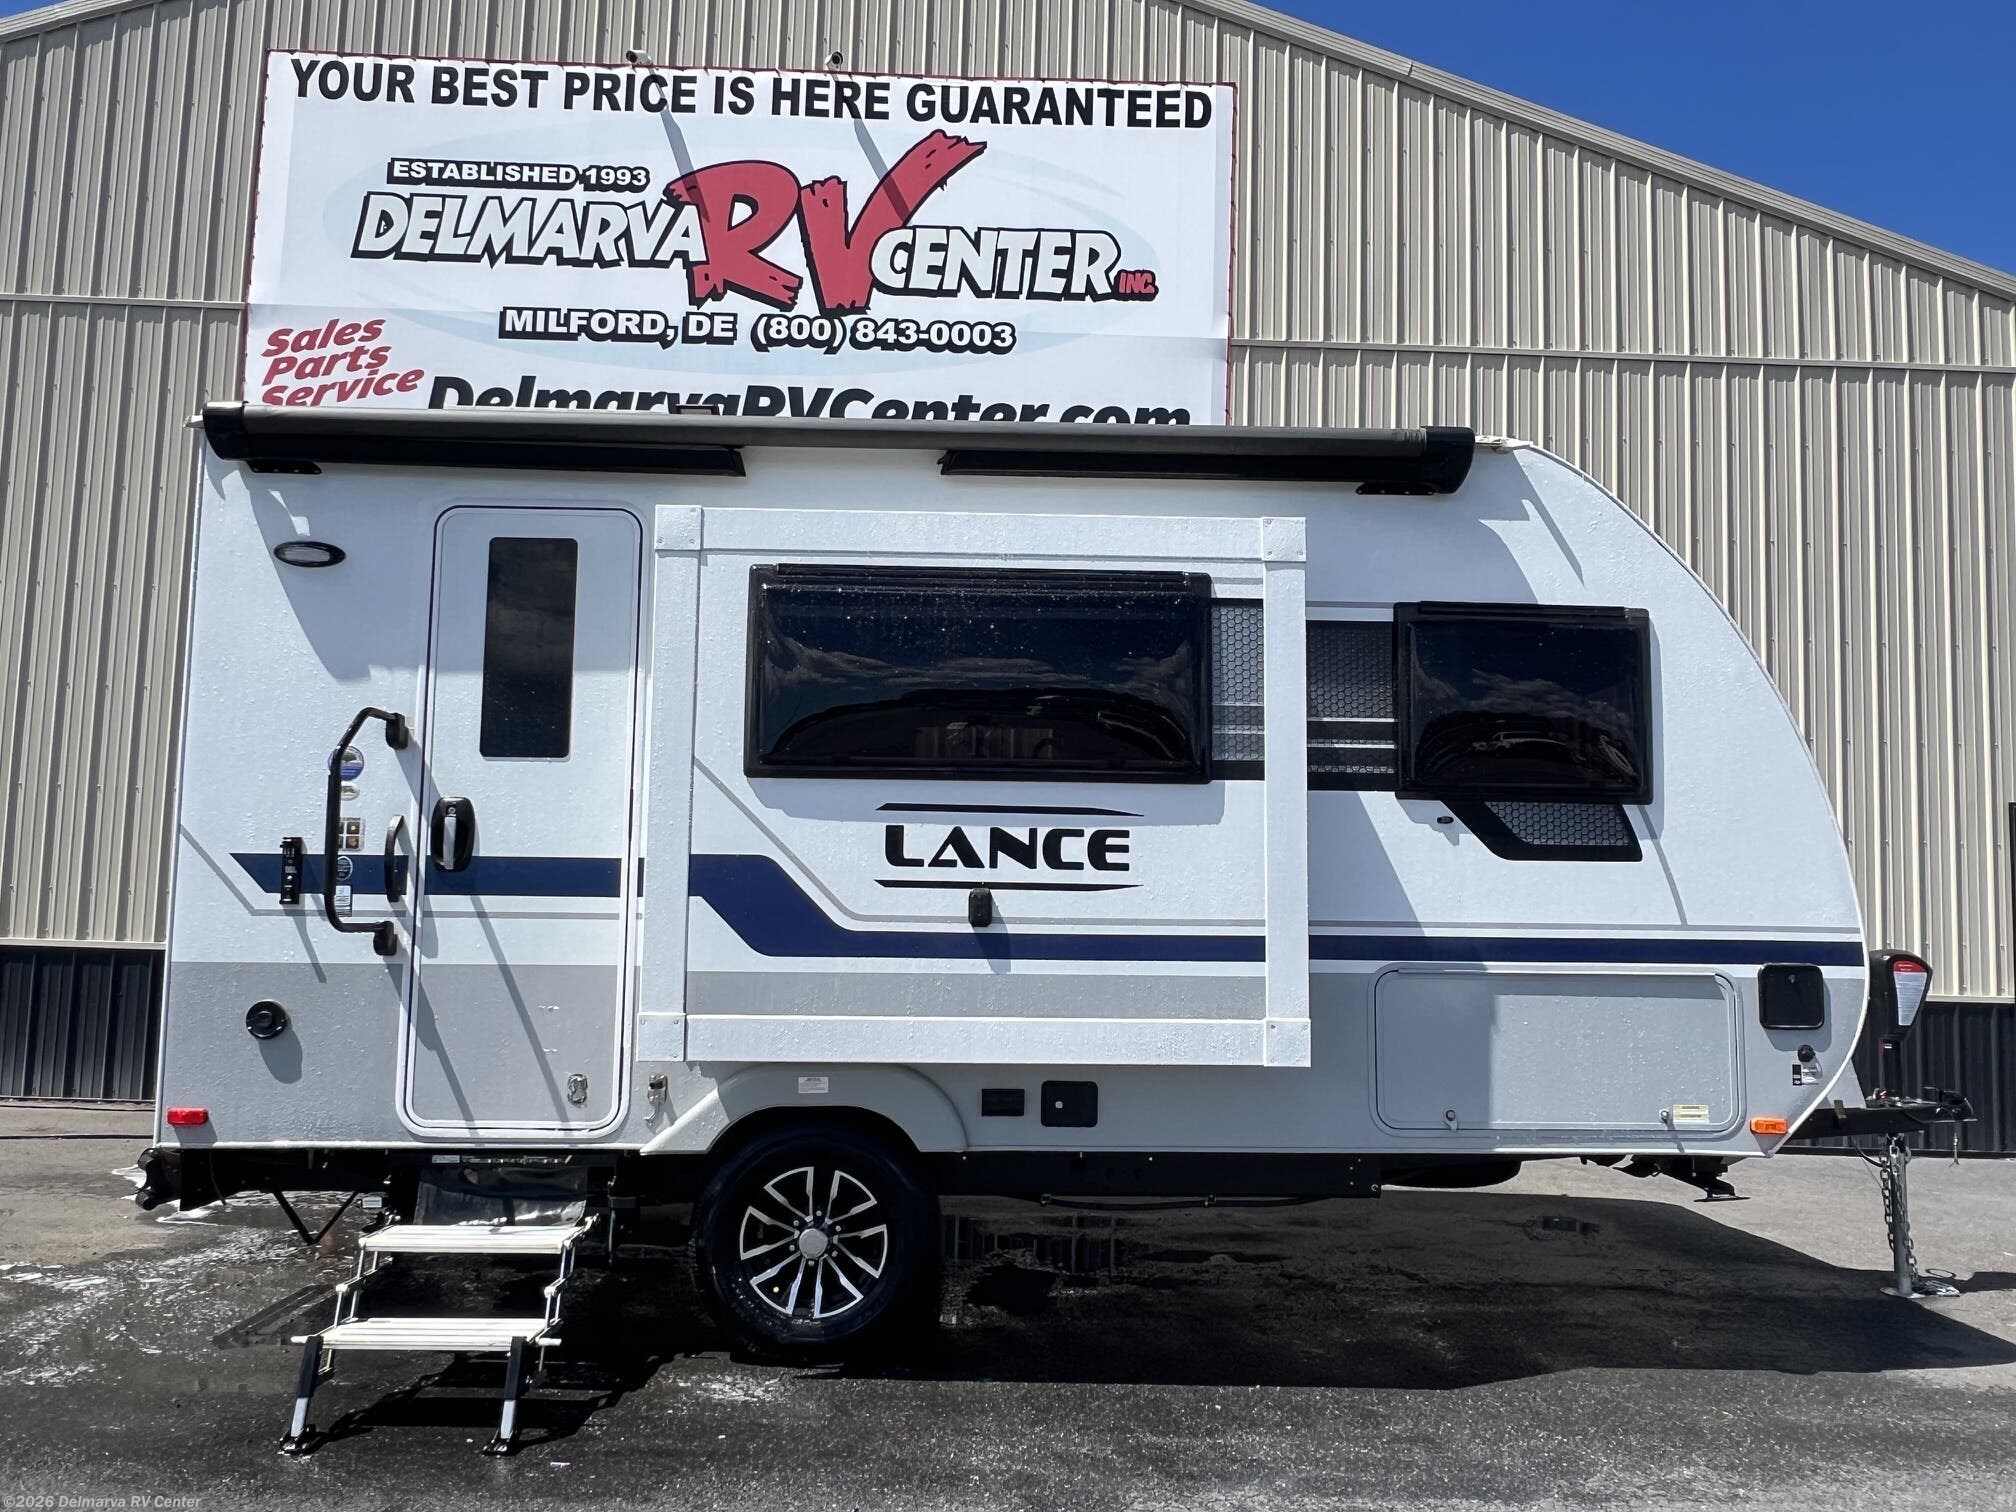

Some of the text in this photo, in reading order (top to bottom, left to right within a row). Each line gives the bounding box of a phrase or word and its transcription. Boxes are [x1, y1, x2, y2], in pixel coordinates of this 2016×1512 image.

[291, 58, 1212, 128] YOUR BEST PRICE IS HERE GUARANTEED
[392, 160, 649, 187] ESTABLISHED 1993
[353, 193, 710, 266] DELMARVA
[664, 130, 987, 314] RV
[870, 226, 1122, 298] CENTER
[261, 318, 387, 357] Sales
[504, 308, 1015, 351] MILFORD, DE (800) 843-0003
[262, 345, 392, 386] Parts
[262, 369, 425, 407] Service
[428, 376, 1191, 425] DelmarvaRVCentercom
[885, 825, 1130, 871] LANCE
